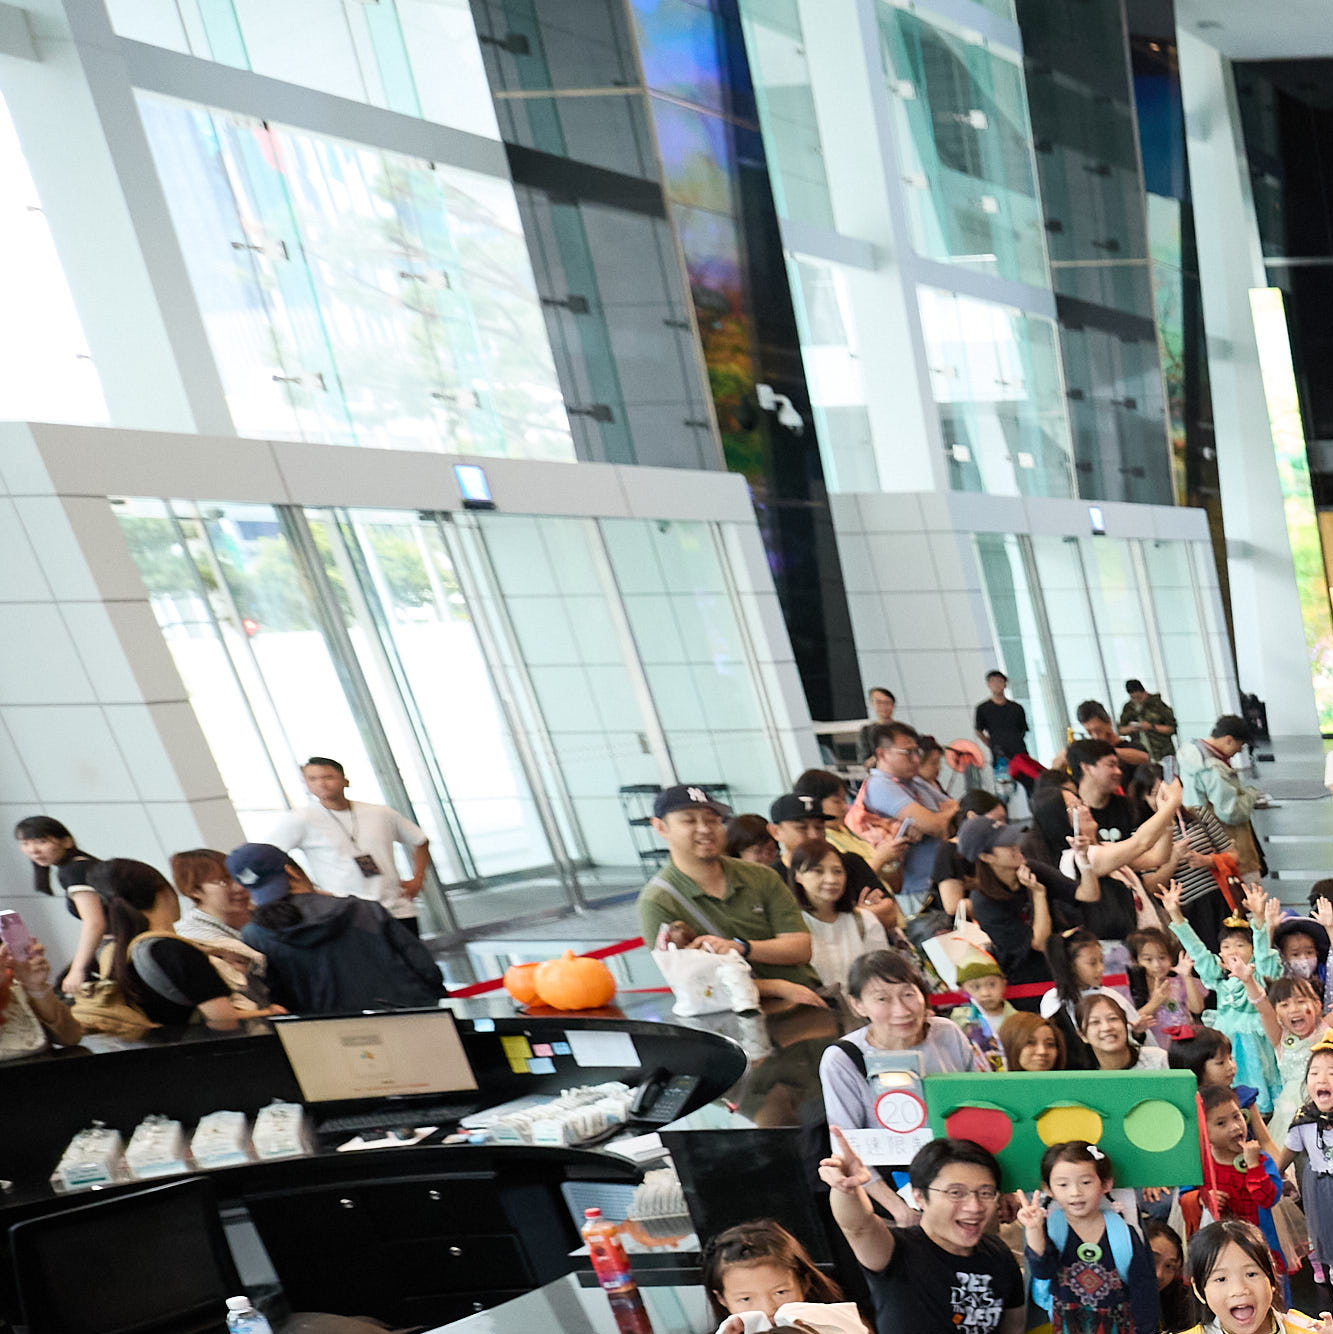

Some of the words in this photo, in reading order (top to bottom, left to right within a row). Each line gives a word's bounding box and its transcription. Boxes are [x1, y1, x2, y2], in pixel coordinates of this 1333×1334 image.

[884, 1099, 920, 1125] 20
[956, 1272, 992, 1292] PET
[950, 1286, 994, 1308] DAYS
